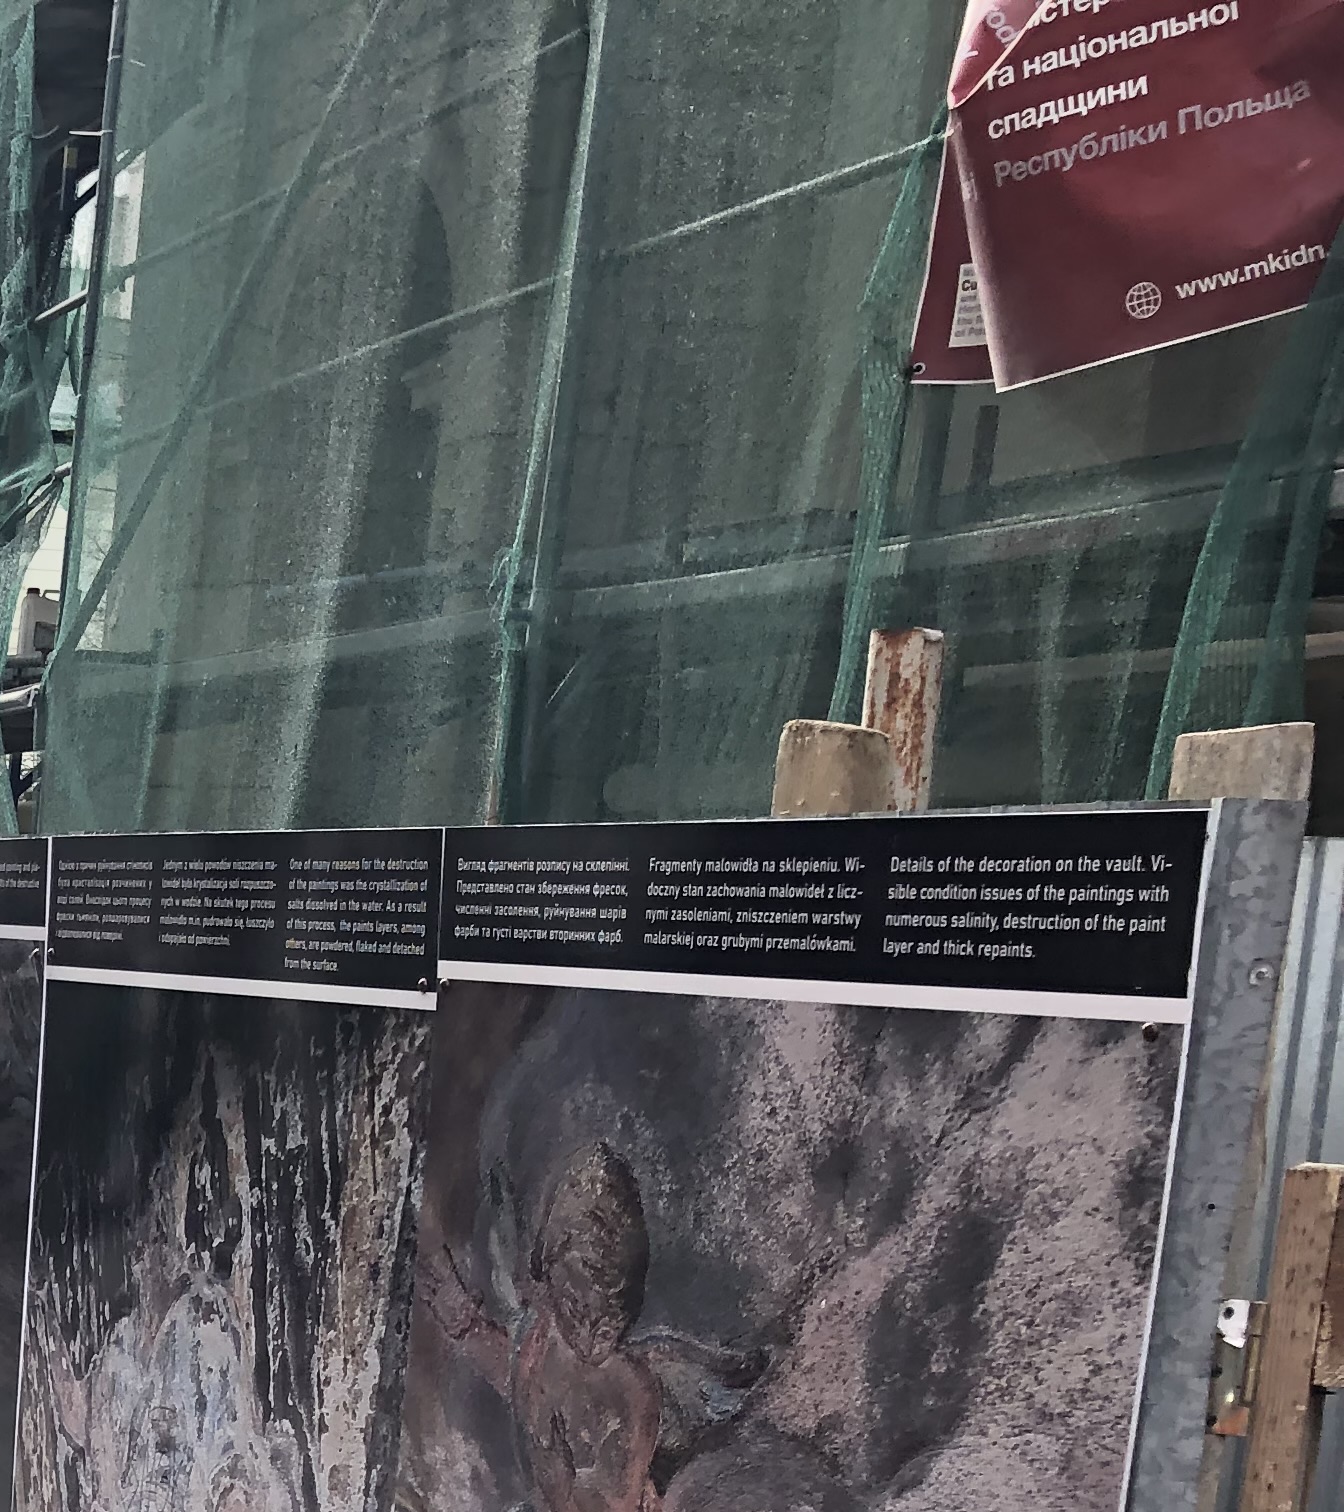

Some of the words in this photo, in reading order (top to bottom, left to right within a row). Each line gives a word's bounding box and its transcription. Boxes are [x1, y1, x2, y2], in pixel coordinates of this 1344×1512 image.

[1023, 1, 1240, 81] національної
[988, 73, 1148, 140] спадщини
[995, 118, 1168, 187] Республіки
[1178, 78, 1311, 137] Польща
[290, 858, 302, 870] One
[304, 858, 311, 870] of
[312, 859, 330, 872] many
[332, 859, 360, 871] reasons
[361, 858, 372, 870] for
[374, 857, 385, 870] the
[387, 857, 428, 871] destruction
[458, 857, 486, 872] Вигляд
[488, 857, 534, 874] фрагментів
[536, 859, 570, 875] розпису
[573, 861, 583, 871] на
[585, 857, 630, 872] склепінні.
[649, 857, 702, 876] Fragmenty
[705, 857, 758, 873] malowidła
[762, 860, 775, 873] na
[779, 857, 840, 876] sklepieniu.
[844, 857, 866, 872] Wi-
[890, 856, 934, 873] Details
[937, 856, 951, 873] of
[954, 855, 975, 873] the
[978, 855, 1051, 873] decoration
[1055, 858, 1073, 873] on
[1078, 855, 1101, 873] the
[1105, 855, 1145, 873] vault.
[1151, 855, 1173, 872] Vi-
[289, 878, 296, 890] of
[297, 878, 306, 890] the
[308, 879, 338, 893] paintings
[341, 881, 354, 891] was
[356, 879, 367, 891] the
[368, 879, 418, 893] crystallization
[420, 879, 428, 892] of
[456, 880, 514, 895] Представлено
[516, 883, 535, 894] стан
[537, 881, 590, 897] збереження
[592, 882, 629, 898] фресок,
[647, 882, 680, 900] doczny
[682, 884, 703, 897] stan
[706, 882, 766, 898] zachowania
[769, 883, 825, 899] malowideł
[828, 887, 834, 899] z
[837, 884, 864, 899] licz-
[888, 884, 916, 900] sible
[920, 884, 977, 901] condition
[980, 884, 1023, 901] issues
[1027, 884, 1042, 902] of
[1044, 884, 1065, 902] the
[1068, 885, 1134, 906] paintings
[1138, 885, 1170, 903] with
[288, 898, 304, 910] salts
[306, 899, 338, 911] dissolved
[340, 900, 347, 911] in
[348, 899, 360, 911] the
[362, 901, 384, 912] water.
[386, 900, 395, 912] As
[398, 903, 402, 913] a
[404, 900, 427, 913] result
[455, 902, 492, 915] численні
[494, 905, 542, 918] засолення,
[544, 903, 596, 921] руйнування
[600, 906, 627, 921] шарів
[287, 918, 293, 929] of
[294, 917, 306, 930] this
[308, 920, 336, 932] process,
[339, 919, 351, 932] the
[353, 920, 373, 935] paints
[376, 920, 399, 935] layers,
[401, 923, 426, 937] among
[645, 907, 669, 924] nymi
[670, 907, 733, 924] zasoleniami,
[736, 908, 808, 924] zniszczeniem
[812, 910, 861, 929] warstwy
[885, 913, 948, 928] numerous
[951, 912, 1000, 933] salinity,
[1003, 913, 1080, 931] destruction
[1084, 914, 1099, 931] of
[1102, 914, 1125, 932] the
[1129, 915, 1167, 936] paint
[454, 924, 479, 940] фарби
[481, 927, 490, 937] та
[492, 925, 512, 940] густі
[514, 928, 547, 943] варстви
[549, 930, 596, 944] вторинних
[597, 929, 624, 945] фарб.
[644, 930, 694, 949] malarskiej
[696, 935, 718, 947] oraz
[721, 934, 763, 951] grubymi
[766, 934, 856, 953] przemalówkami.
[285, 938, 307, 951] others,
[309, 940, 320, 951] are
[321, 939, 354, 954] powdered,
[356, 939, 377, 953] flaked
[378, 941, 391, 954] and
[393, 942, 425, 955] detached
[883, 938, 914, 958] layer
[917, 939, 940, 956] and
[943, 939, 974, 957] thick
[978, 942, 1036, 961] repaints.
[284, 956, 299, 969] from
[301, 957, 311, 970] the
[313, 958, 339, 972] surface.
